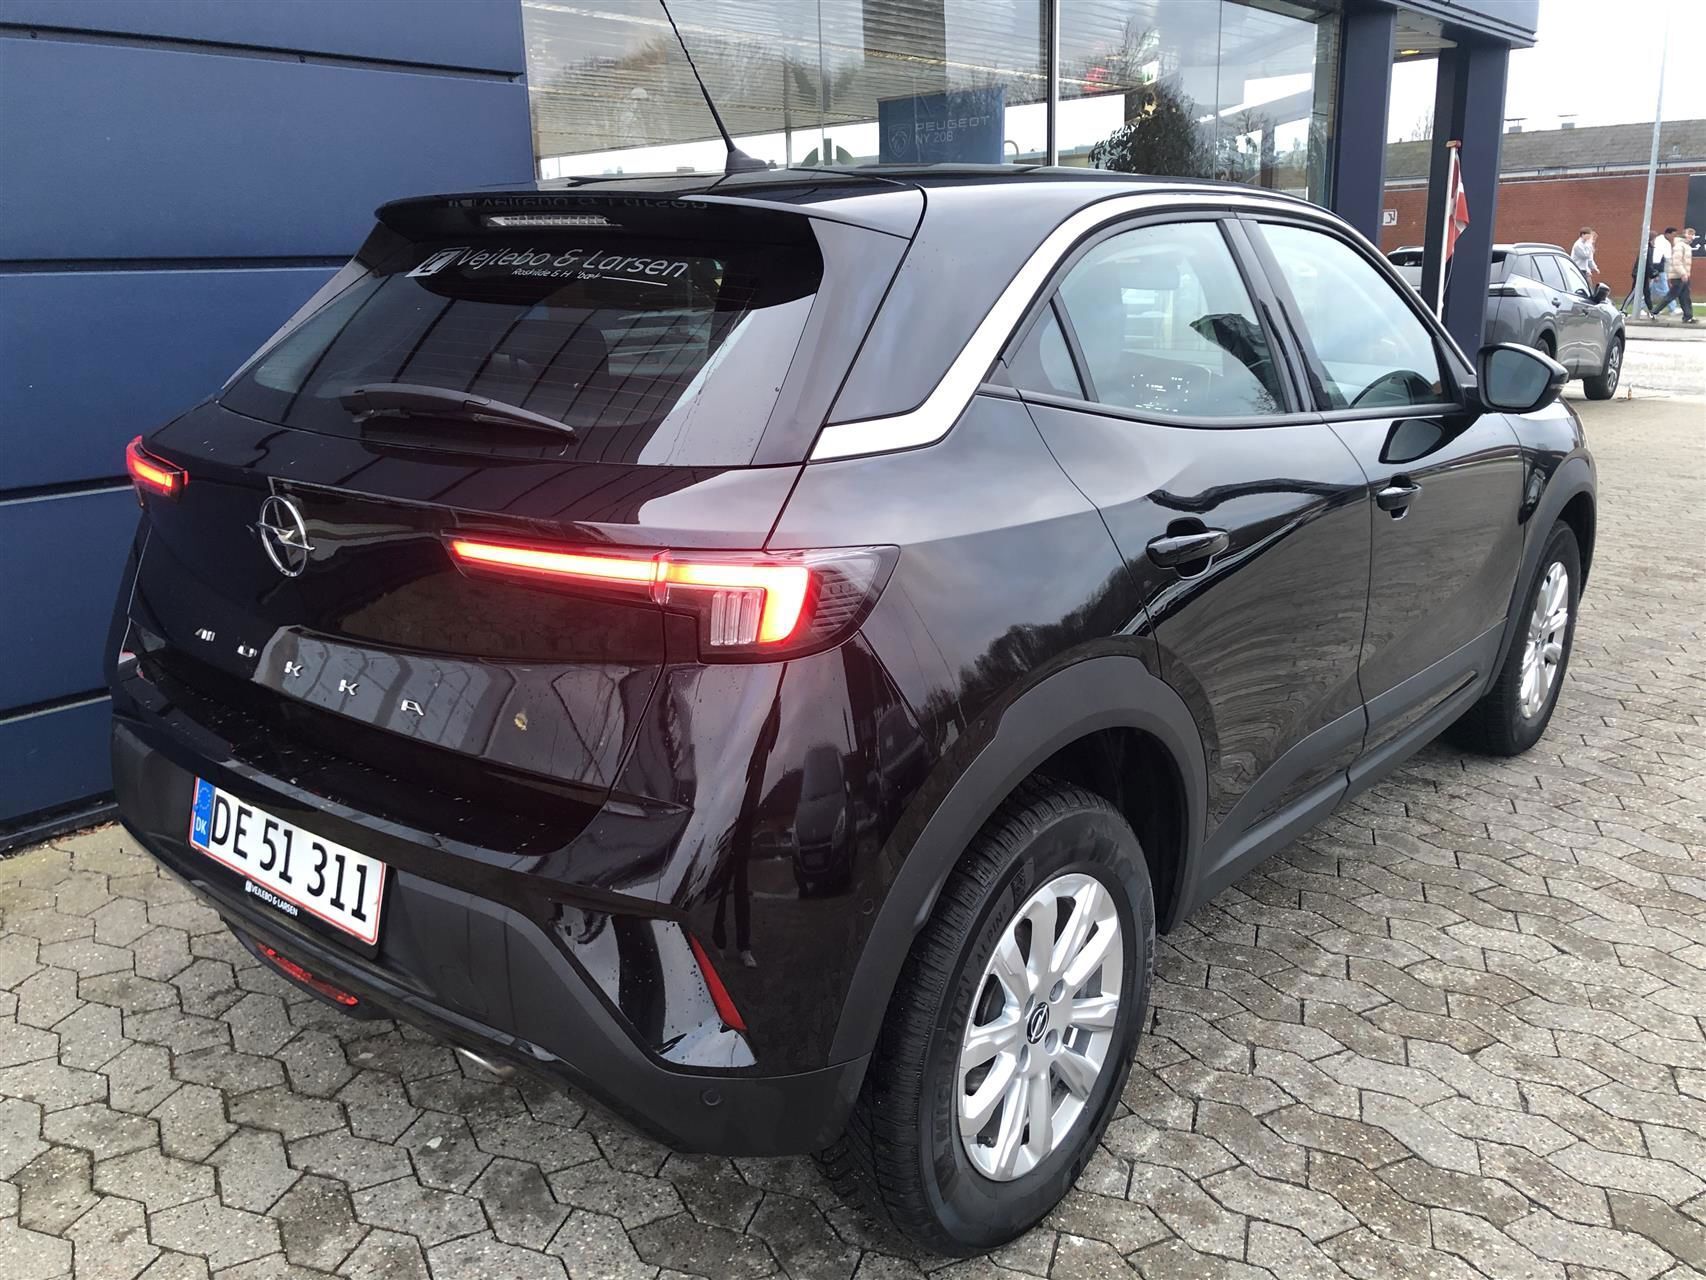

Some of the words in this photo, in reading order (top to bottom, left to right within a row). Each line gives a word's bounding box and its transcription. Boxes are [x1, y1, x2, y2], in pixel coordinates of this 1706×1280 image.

[915, 115, 990, 131] PEUGEOT
[915, 133, 929, 144] NY
[457, 249, 551, 270] Vejlebo
[553, 249, 583, 267] &
[582, 250, 689, 278] Larsen
[195, 816, 208, 836] DK
[211, 794, 252, 860] DE
[259, 817, 294, 884] 51
[307, 841, 368, 923] 311
[277, 899, 298, 916] LARSEN
